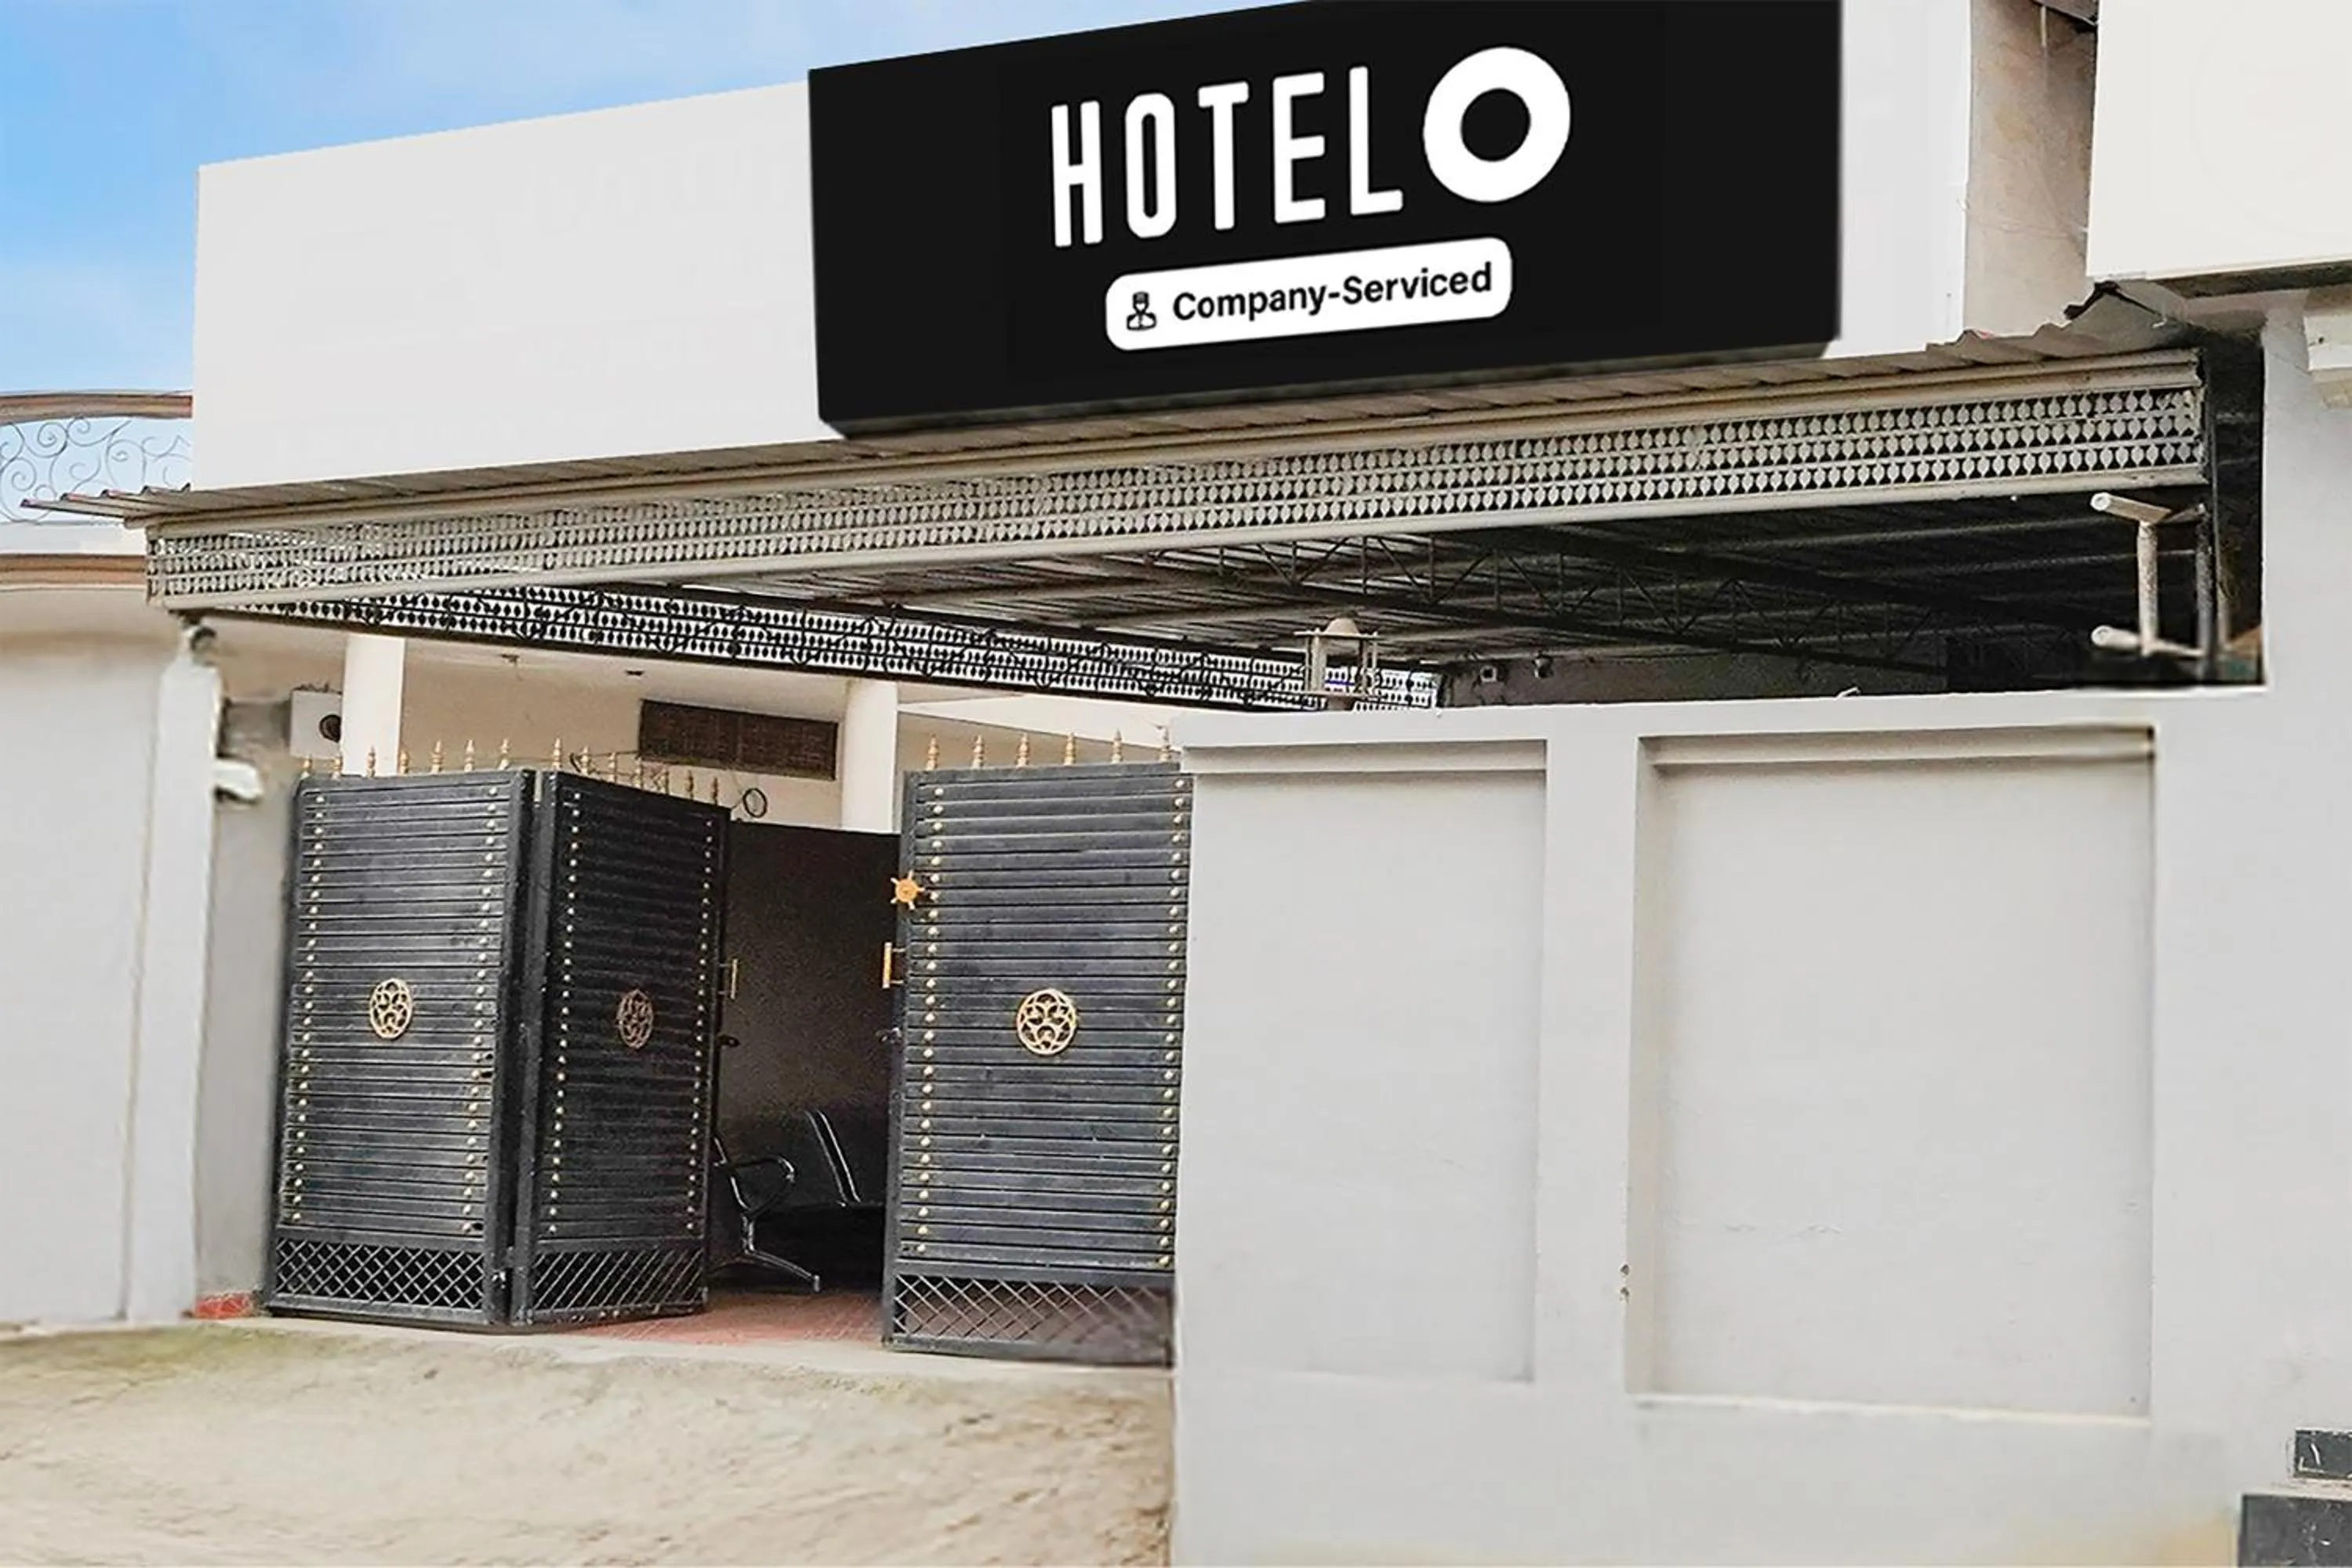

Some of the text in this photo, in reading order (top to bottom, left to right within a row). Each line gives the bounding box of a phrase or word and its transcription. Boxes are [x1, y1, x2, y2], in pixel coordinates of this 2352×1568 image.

[1051, 47, 1570, 247] HOTEL O
[1173, 261, 1492, 321] Company-Serviced
